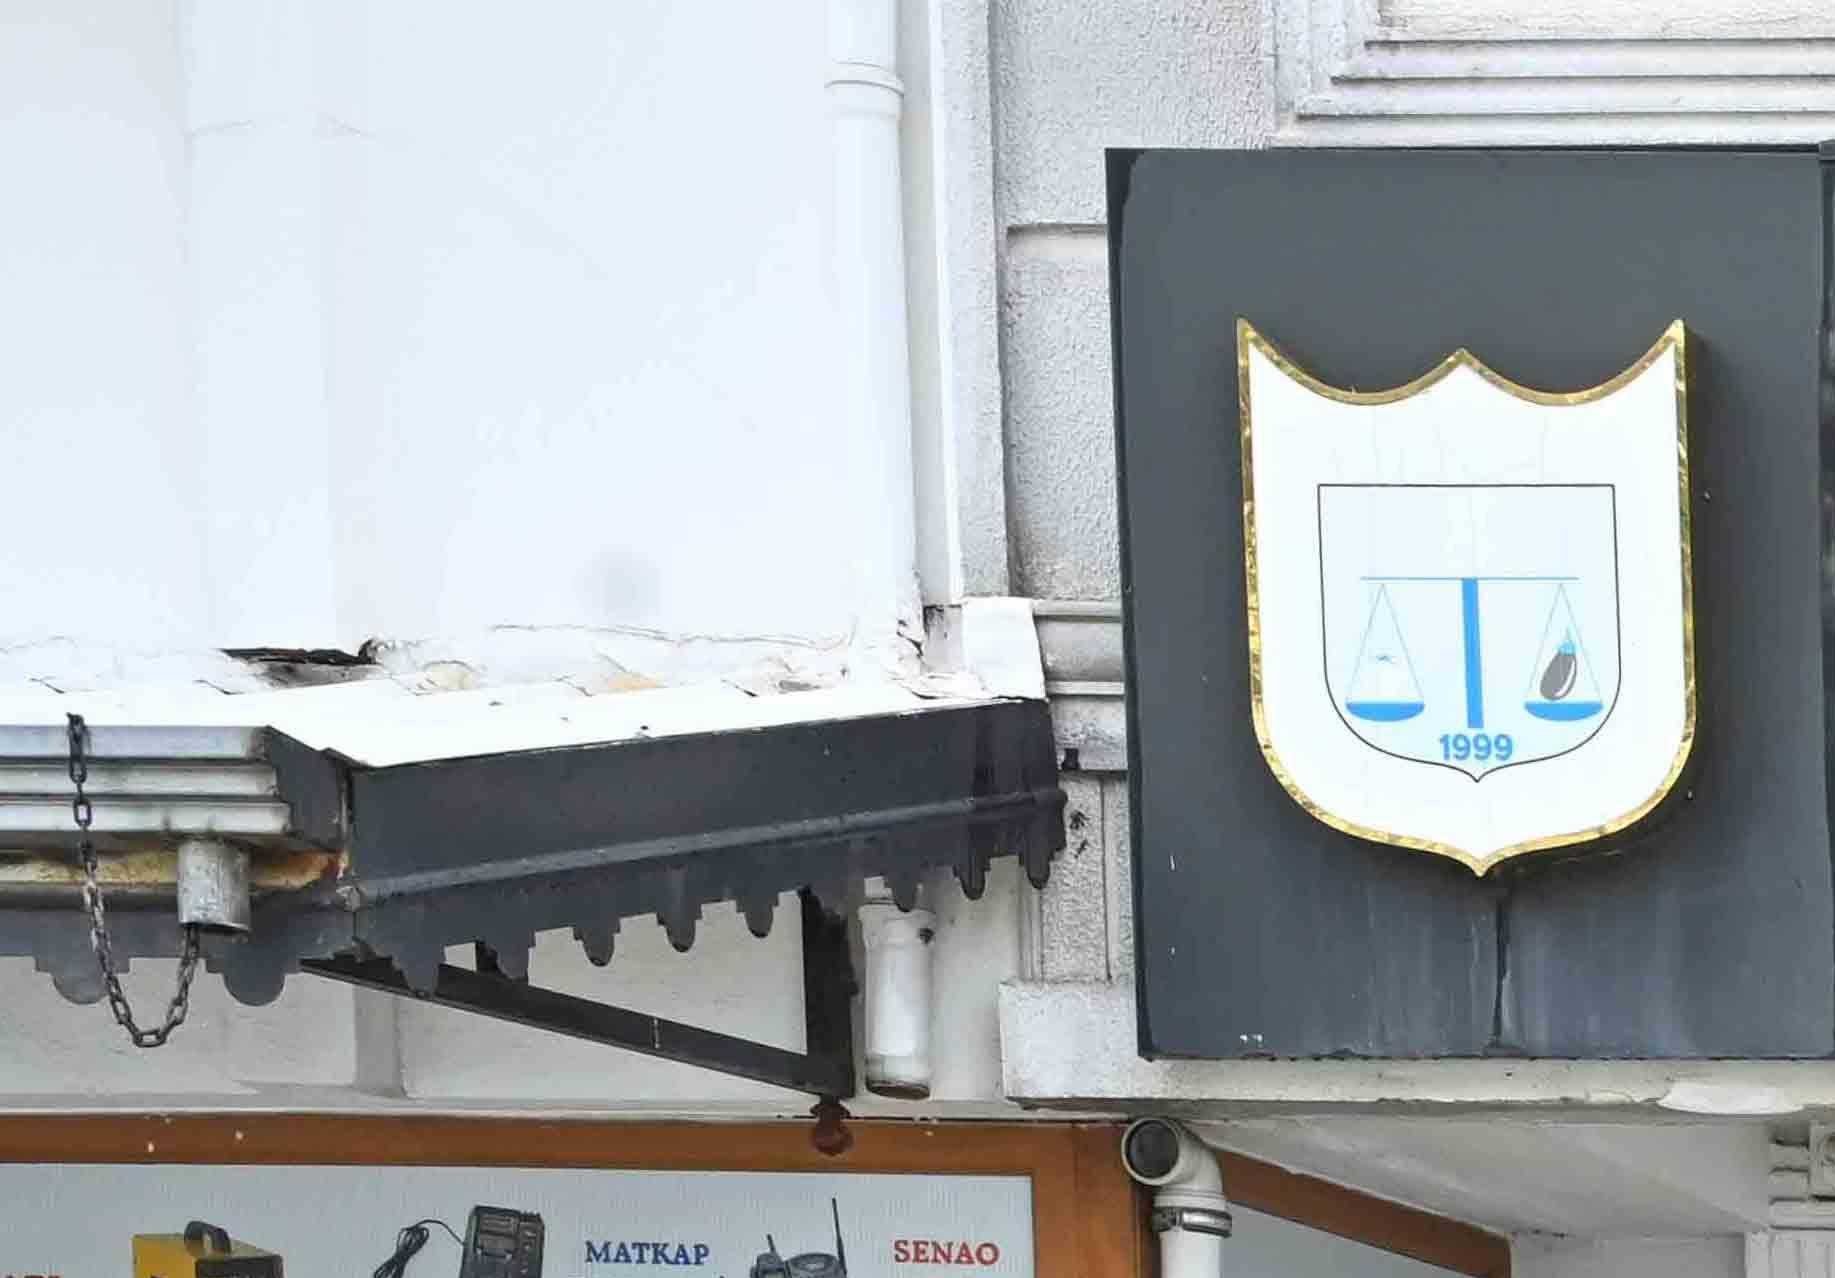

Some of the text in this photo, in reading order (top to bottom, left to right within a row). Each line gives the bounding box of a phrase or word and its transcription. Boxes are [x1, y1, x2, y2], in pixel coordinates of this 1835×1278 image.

[1439, 732, 1514, 762] 1999
[585, 1241, 709, 1266] MATKAP
[893, 1239, 1000, 1266] SENAO
